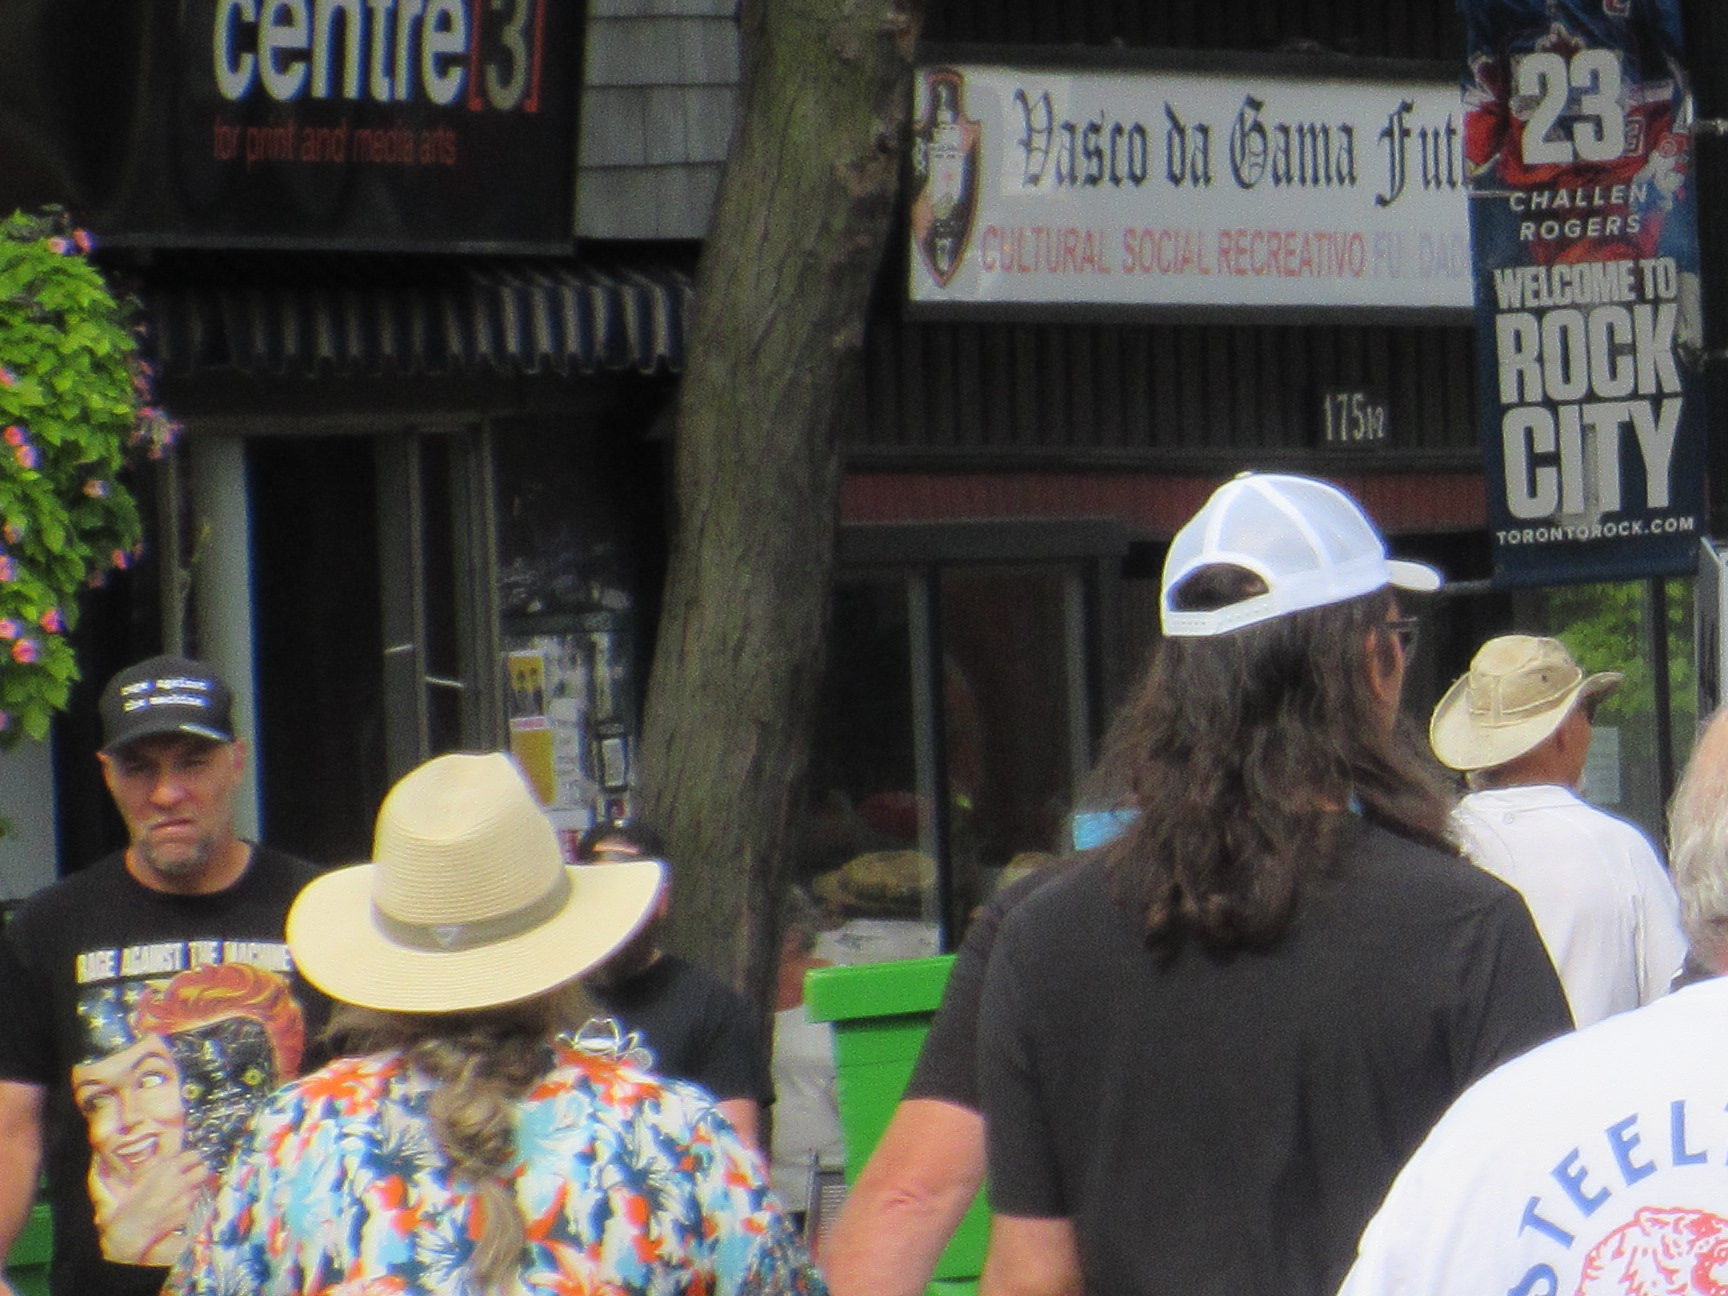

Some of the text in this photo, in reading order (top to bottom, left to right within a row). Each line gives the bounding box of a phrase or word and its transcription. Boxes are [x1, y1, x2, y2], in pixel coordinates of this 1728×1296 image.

[1515, 49, 1626, 165] 23
[1013, 88, 1147, 188] Vasco
[1163, 100, 1211, 188] da
[1230, 93, 1359, 189] Gama
[1509, 184, 1649, 211] CHALLEN
[982, 225, 1111, 274] CULTURAL
[1122, 227, 1212, 275] SOCIAL
[1217, 229, 1367, 278] RECREATIVO
[1519, 215, 1642, 241] ROGERS
[1493, 257, 1677, 308] WELCOME TO
[1496, 303, 1682, 404] ROCK
[1502, 397, 1683, 519] CITY
[1496, 516, 1695, 546] TORONTOROCK.COM
